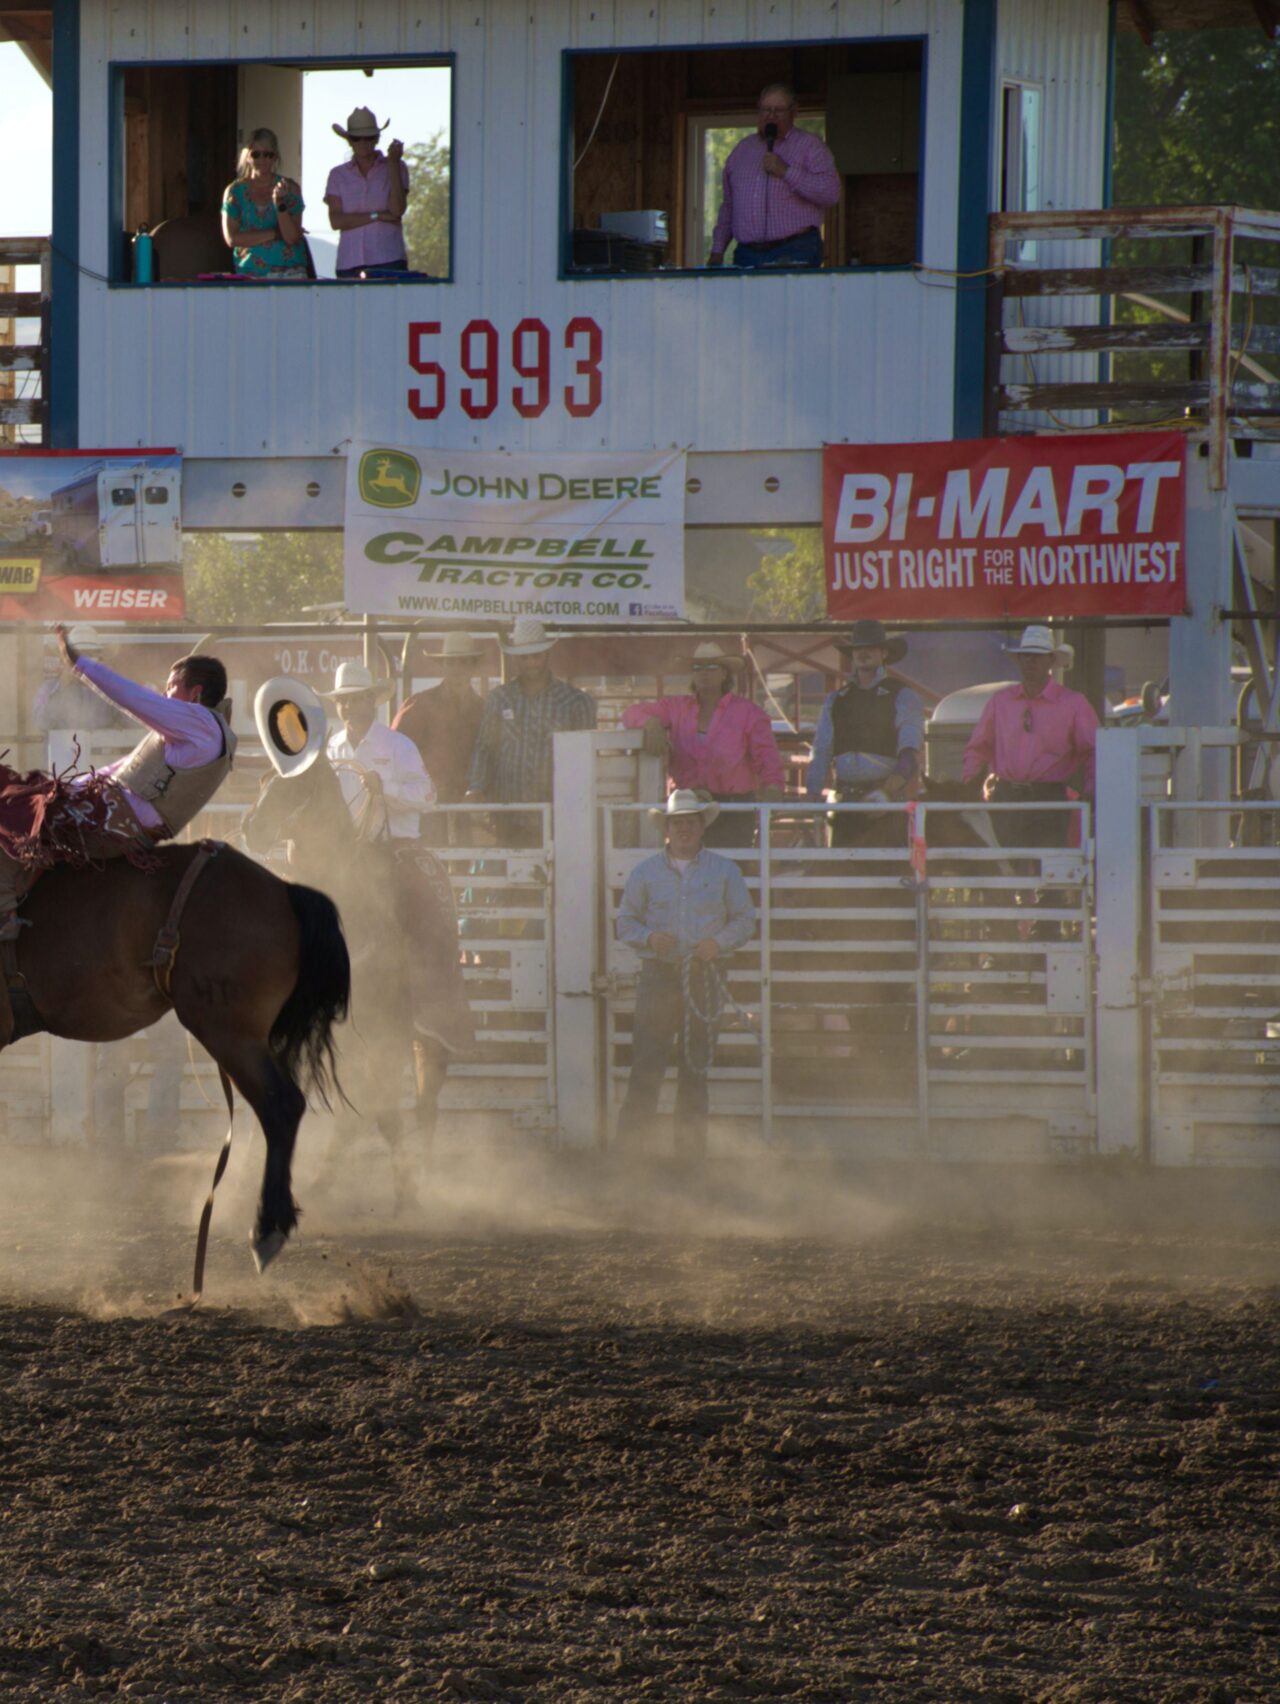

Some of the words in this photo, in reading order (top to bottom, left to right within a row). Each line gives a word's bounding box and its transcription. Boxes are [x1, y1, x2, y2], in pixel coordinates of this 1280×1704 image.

[407, 316, 603, 420] 5993
[430, 469, 529, 500] JOHN
[538, 473, 663, 501] DEERE
[833, 461, 1181, 544] BI-MART
[364, 531, 655, 565] CAMPBELL
[983, 549, 1014, 566] FOR
[1020, 541, 1181, 586] NORTHWEST
[414, 559, 583, 589] TRACTOR
[591, 572, 652, 589] CO.
[832, 550, 893, 590] JUST
[898, 547, 978, 589] RIGHT
[983, 567, 1014, 585] THE
[73, 589, 168, 609] WEISER
